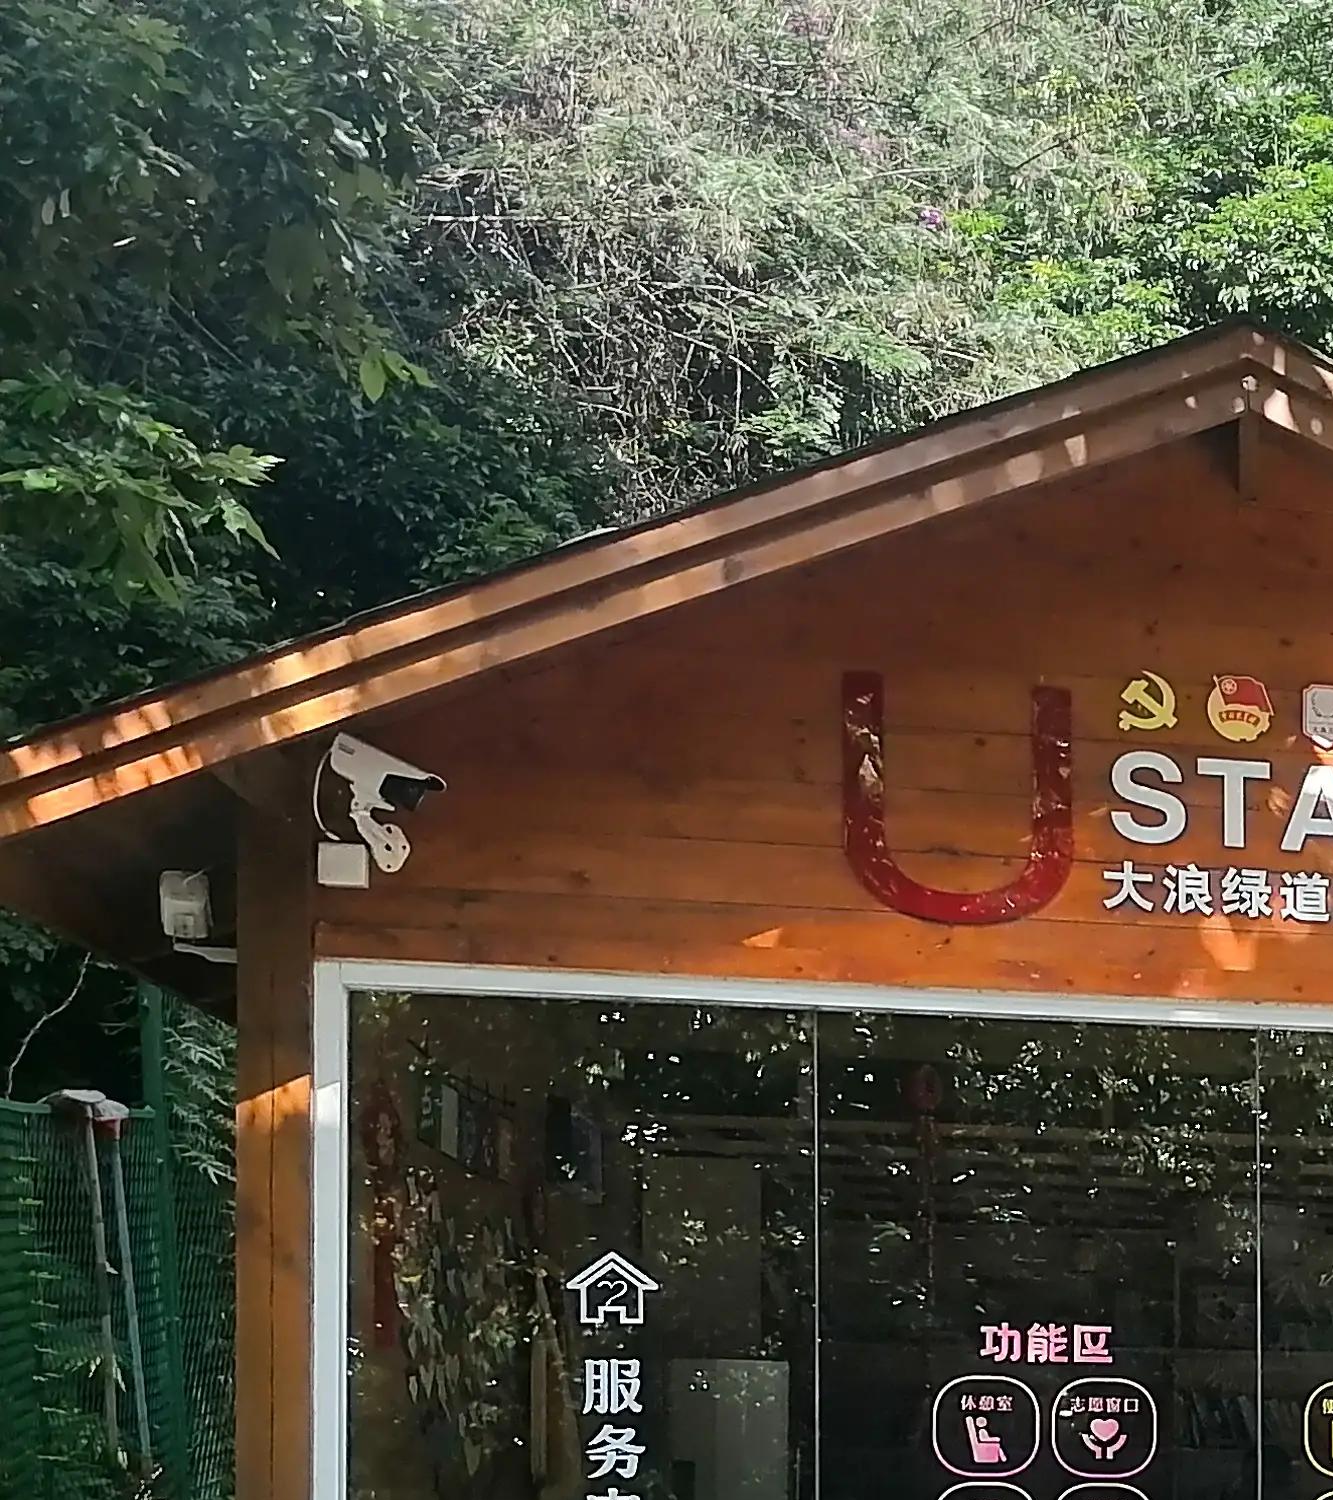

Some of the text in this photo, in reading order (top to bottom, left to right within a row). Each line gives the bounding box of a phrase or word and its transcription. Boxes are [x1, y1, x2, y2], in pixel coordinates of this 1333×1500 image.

[843, 671, 1072, 924] U
[979, 1322, 1113, 1364] 功能区
[1070, 1397, 1139, 1414] 志愿窗口
